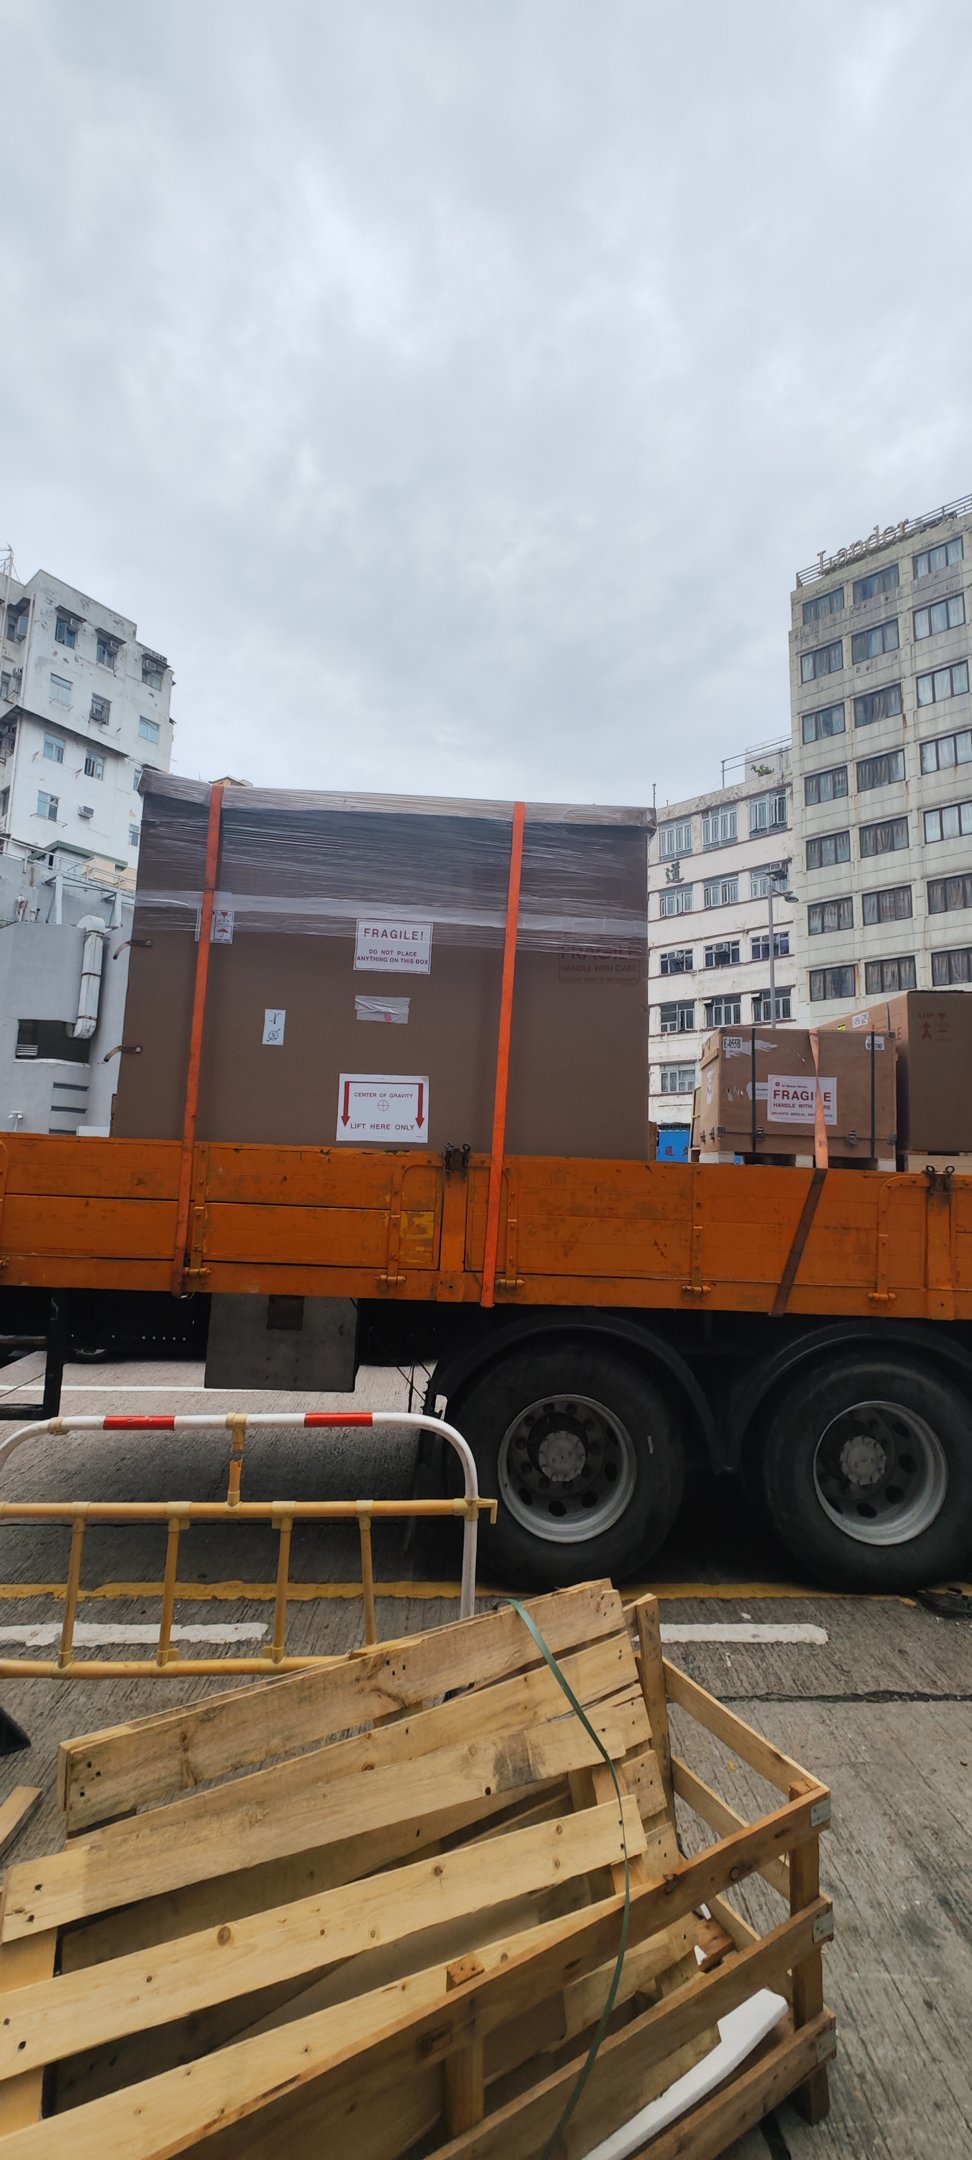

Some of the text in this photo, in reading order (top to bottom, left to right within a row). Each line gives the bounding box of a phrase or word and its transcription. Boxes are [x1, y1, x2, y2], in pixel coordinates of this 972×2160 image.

[363, 927, 424, 941] FRAGILE!
[356, 955, 388, 963] ANYTHING
[773, 1089, 832, 1102] FRAGIE
